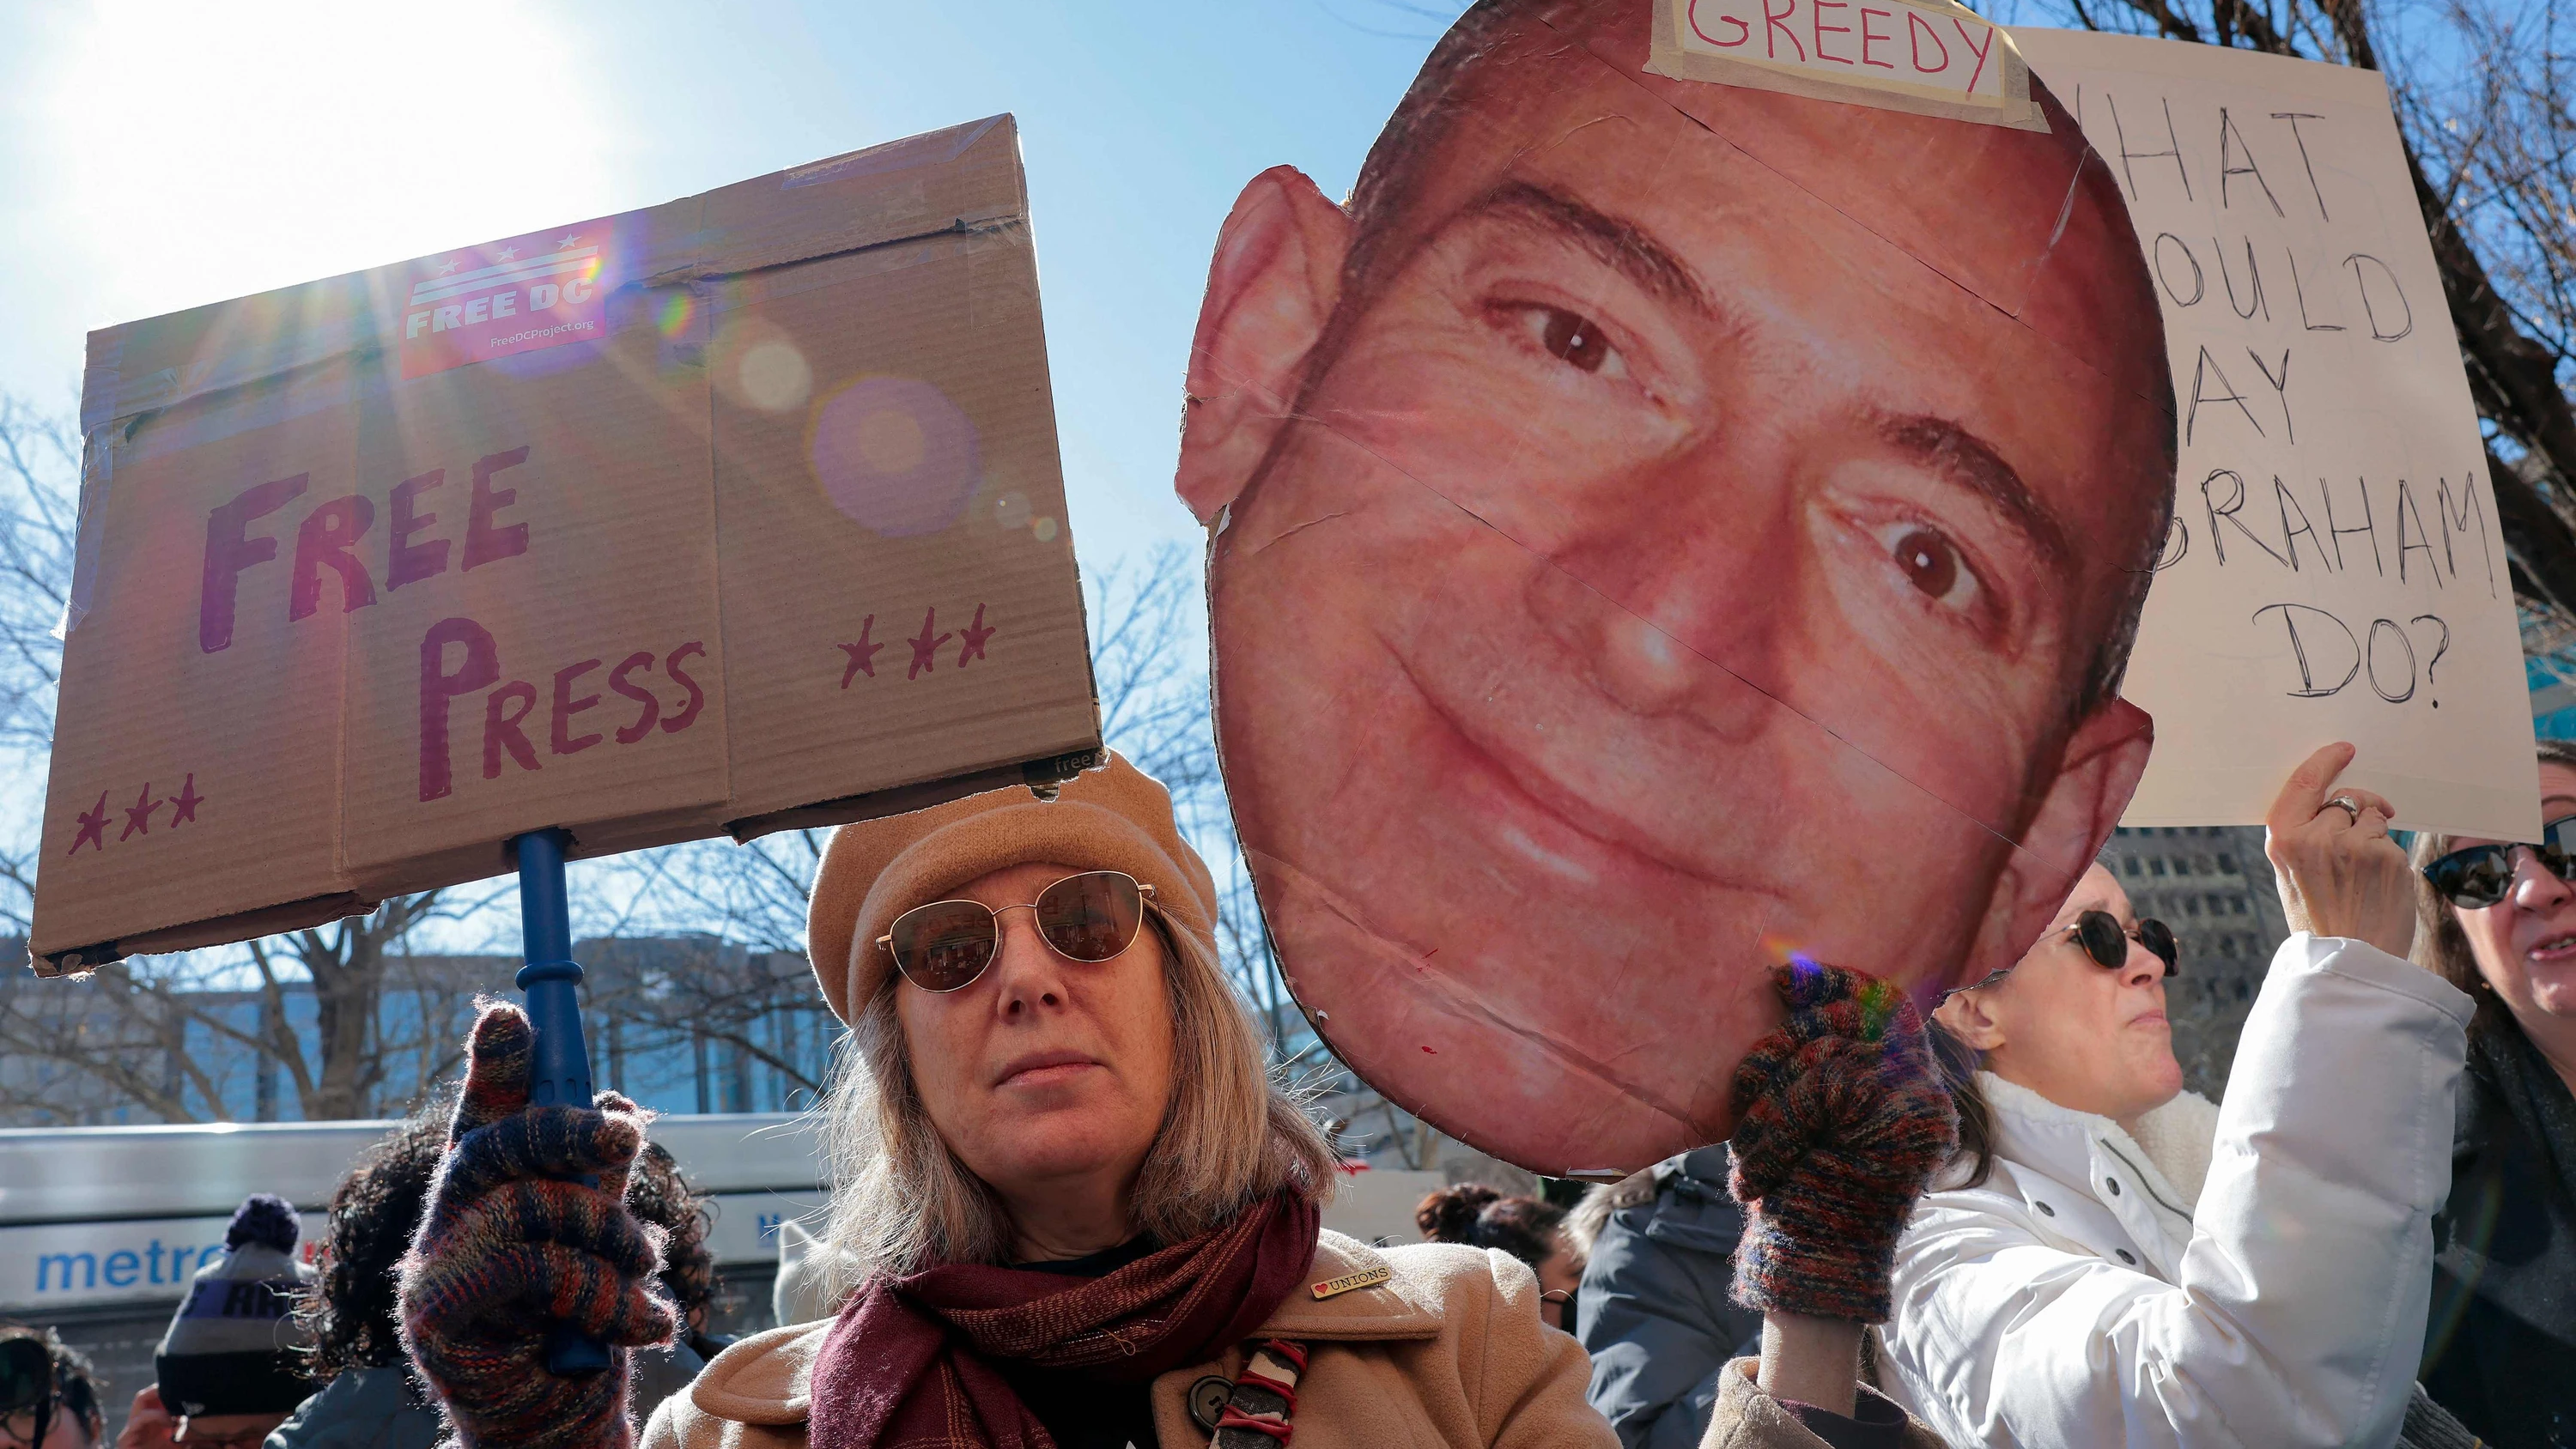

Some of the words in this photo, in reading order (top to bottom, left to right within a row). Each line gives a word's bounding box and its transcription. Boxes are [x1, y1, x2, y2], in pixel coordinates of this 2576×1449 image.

[1688, 0, 1994, 100] GREEDY
[2075, 82, 2329, 222] HAT
[405, 289, 518, 340] FREE
[529, 276, 593, 312] DC
[489, 318, 595, 349] FreeDCProject.org
[2154, 232, 2413, 343] OULD
[2186, 344, 2294, 447] AY
[199, 445, 530, 654] FREE
[2251, 603, 2451, 708] DO?
[419, 616, 707, 803] PRESS
[1054, 754, 1091, 773] free
[1328, 1267, 1389, 1291] UNIONS
